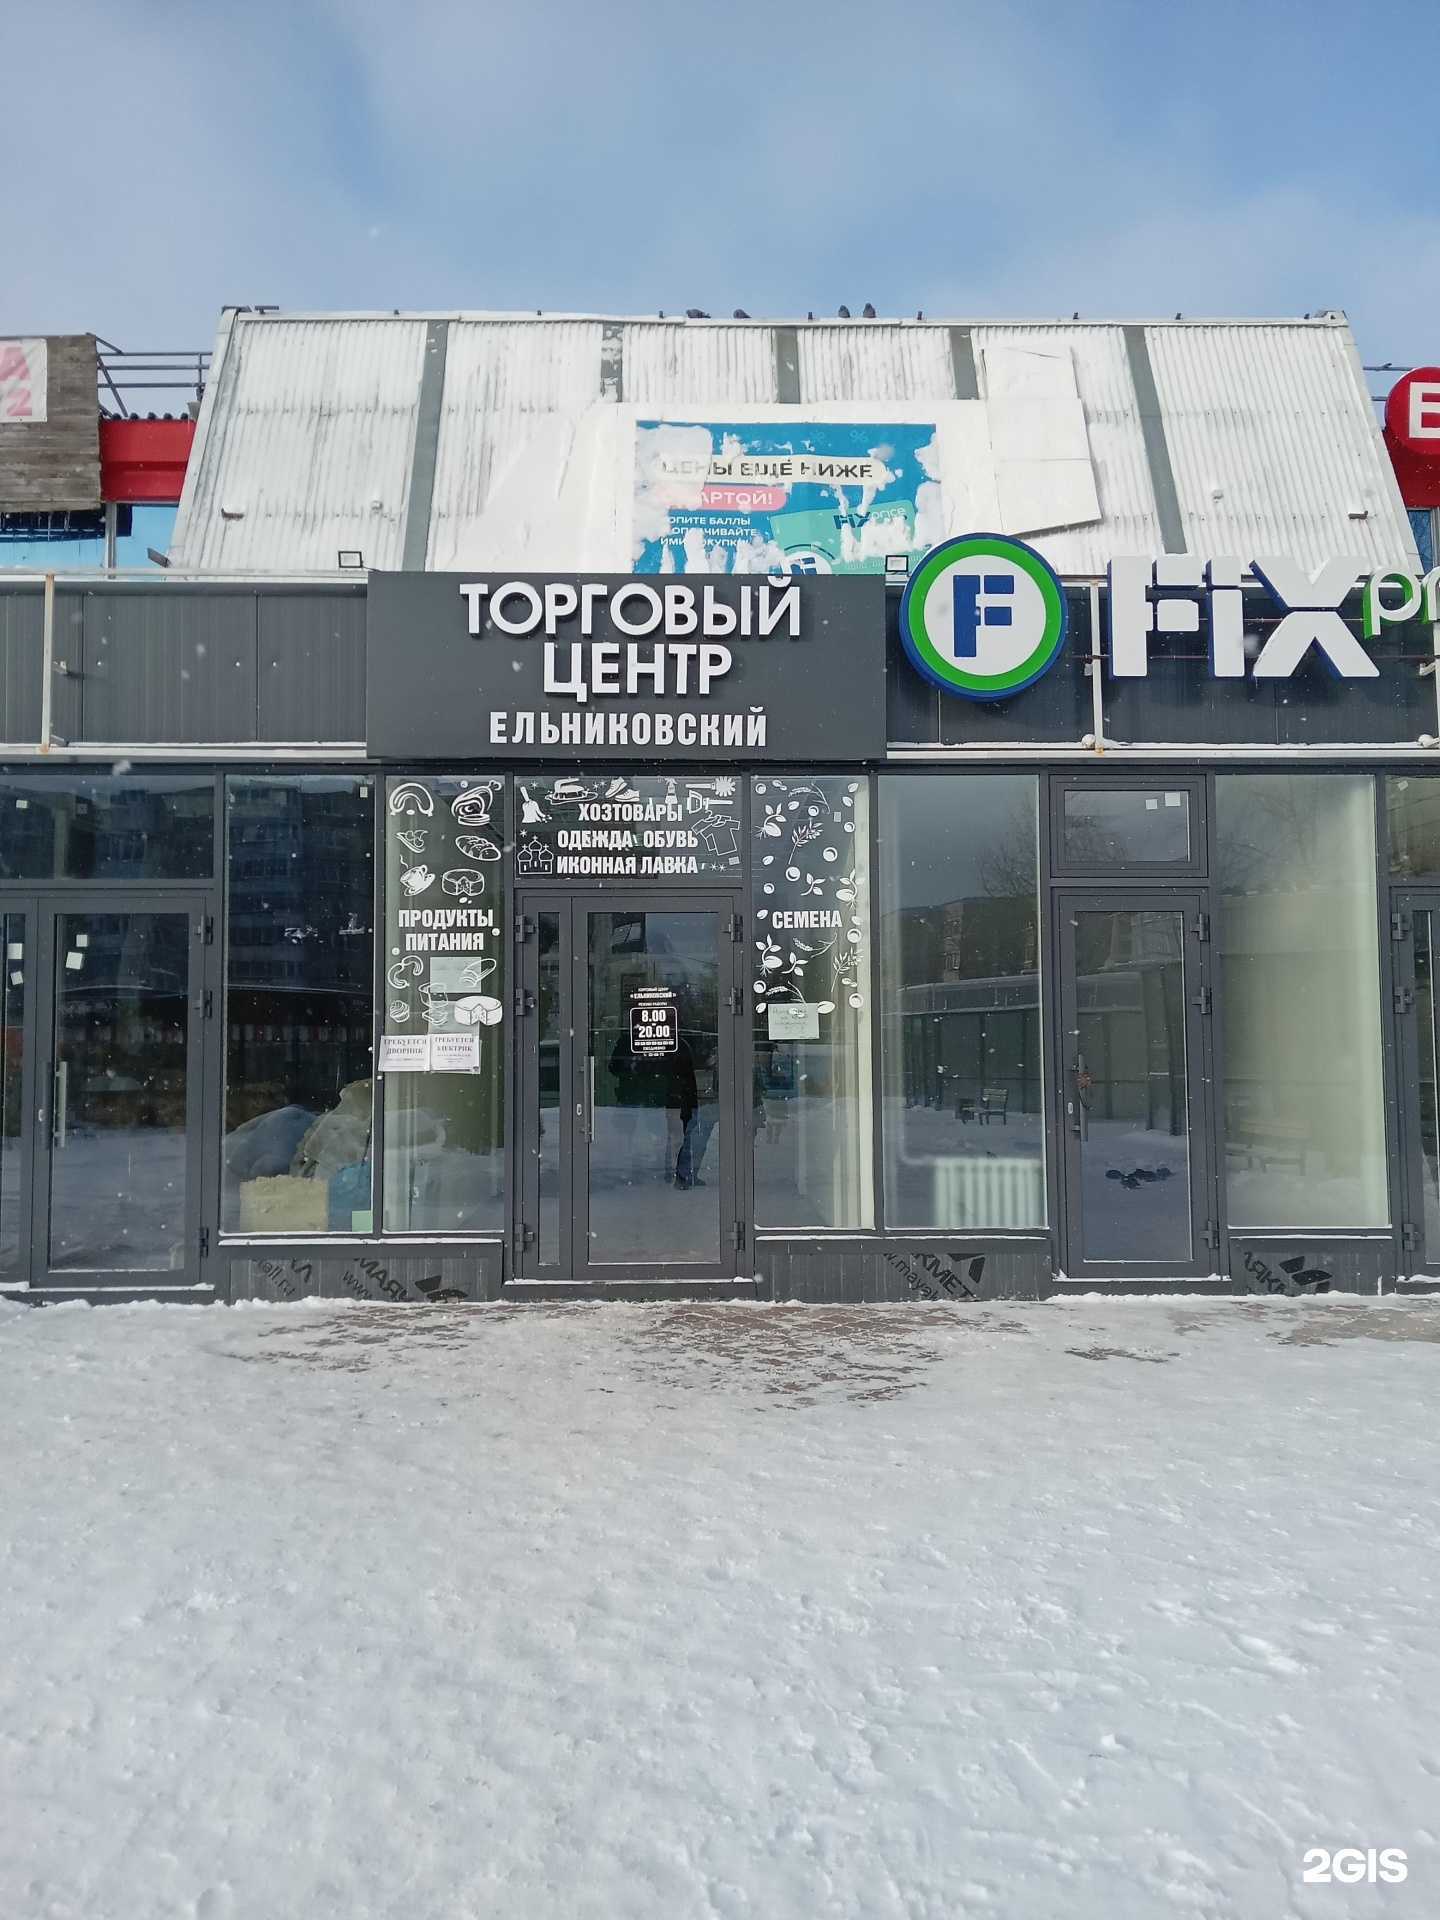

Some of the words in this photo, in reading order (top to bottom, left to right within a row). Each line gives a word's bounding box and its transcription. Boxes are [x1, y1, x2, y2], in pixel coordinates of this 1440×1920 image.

[709, 517, 751, 526] БАЛЛЫ
[459, 576, 801, 637] ТОРГОВЫЙ
[543, 642, 733, 703] ЦЕНТР
[489, 706, 768, 747] ЕЛЬНИКОВСКИЙ
[578, 803, 684, 823] ХОЗТОВАРЫ
[557, 830, 634, 850] ОДЕЖДА
[643, 830, 699, 848] ОБУВЬ
[556, 856, 637, 874] ИКОННАЯ
[640, 855, 699, 874] ЛАВКА
[398, 909, 494, 930] ПРОДУКТЫ
[772, 910, 843, 929] СЕМЕНА
[405, 932, 484, 951] ПИТАНИЯ
[641, 1010, 666, 1022] 8.00
[638, 1025, 670, 1038] 20.00
